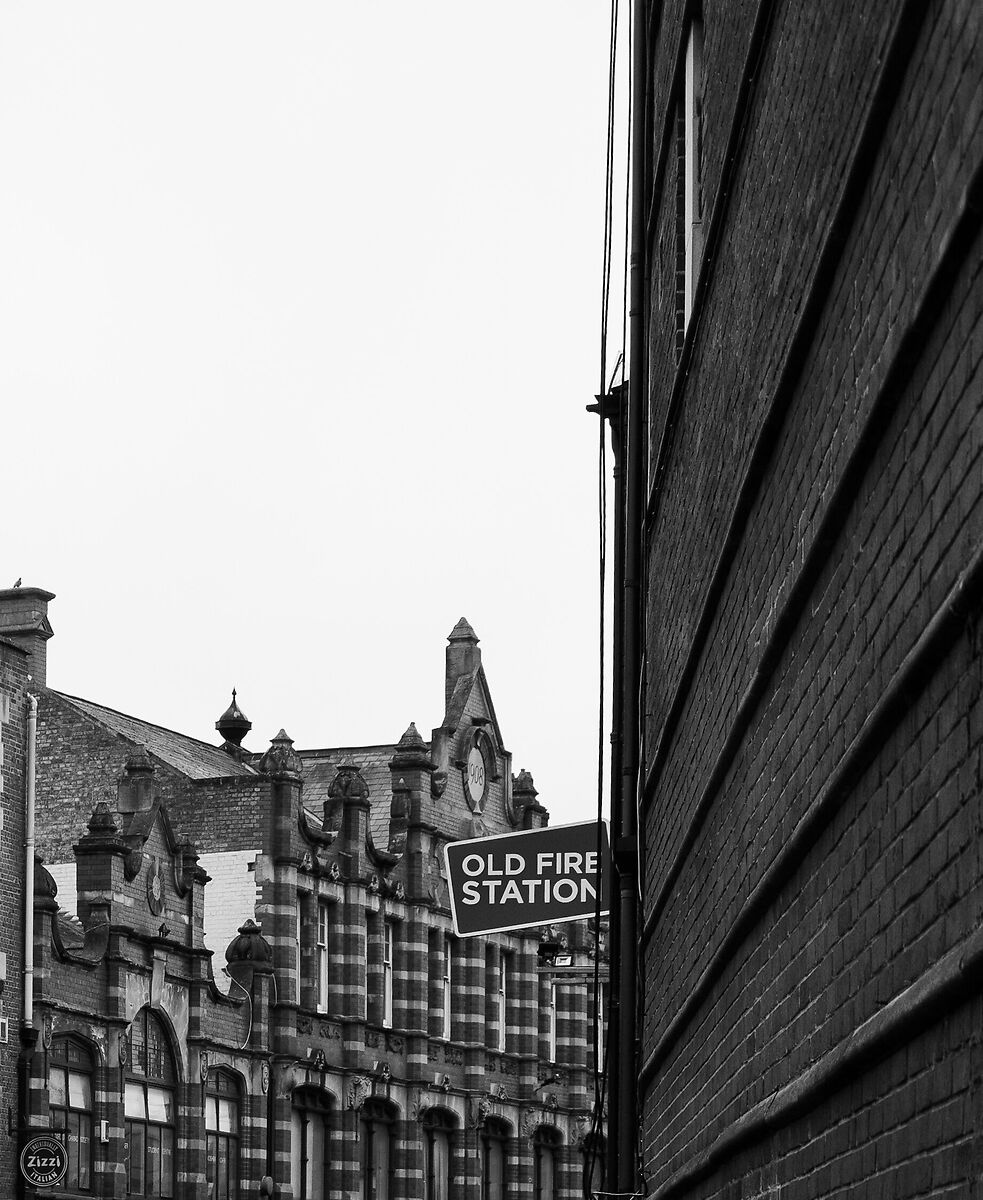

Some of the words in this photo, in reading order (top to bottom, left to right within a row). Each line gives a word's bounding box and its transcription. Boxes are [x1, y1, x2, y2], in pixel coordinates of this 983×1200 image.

[461, 853, 526, 877] OLD
[536, 852, 602, 875] FIRE
[461, 878, 602, 905] STATION
[27, 1155, 61, 1168] Zizzi
[30, 1171, 58, 1182] ITALIAN
